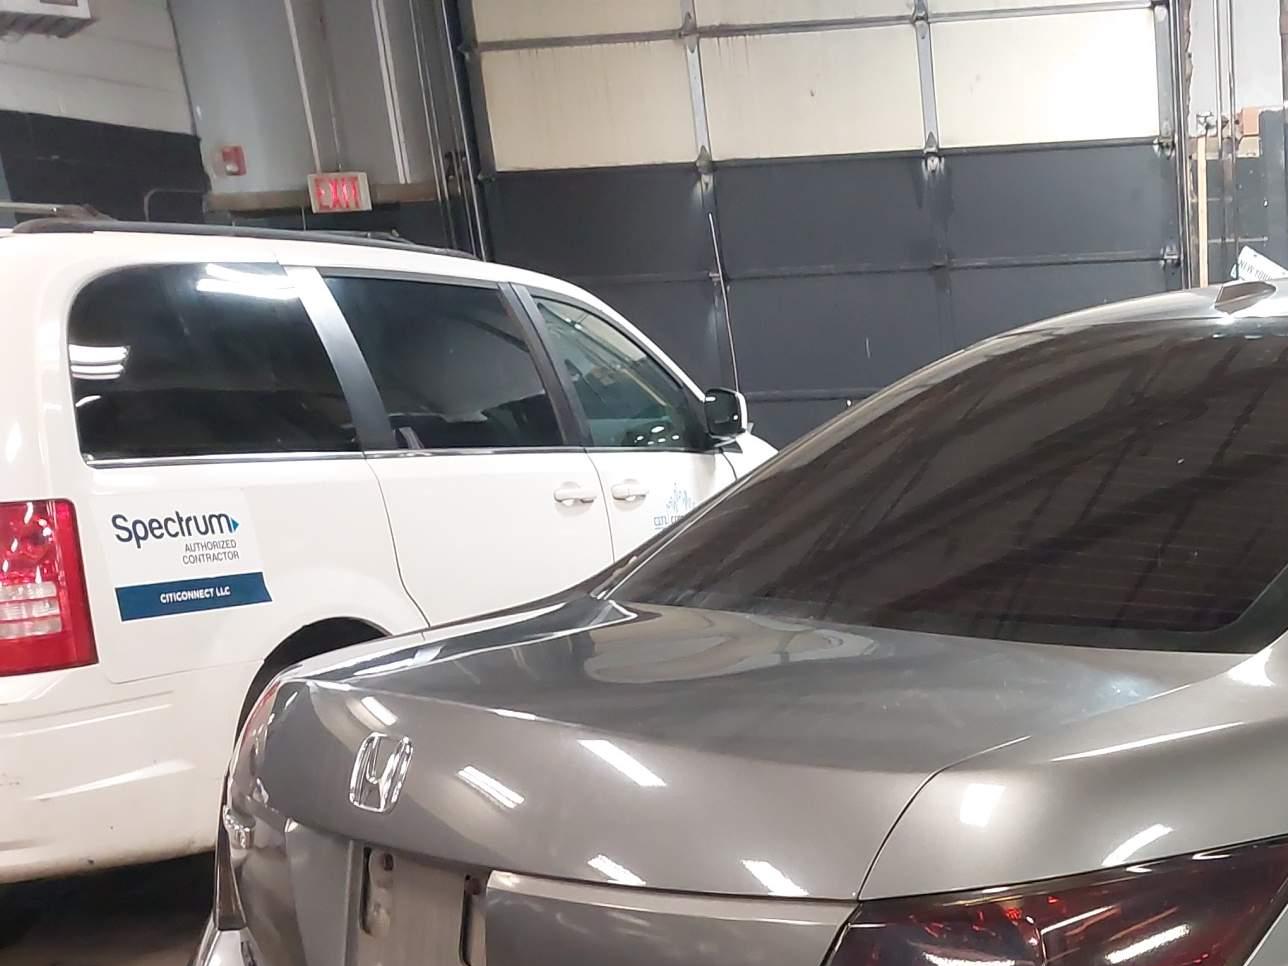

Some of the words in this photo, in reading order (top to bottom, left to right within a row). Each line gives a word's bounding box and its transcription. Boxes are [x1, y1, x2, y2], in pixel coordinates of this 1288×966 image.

[314, 176, 361, 209] EXIT
[111, 511, 233, 549] Spectrum
[185, 539, 237, 552] AUTHORIZED
[182, 551, 240, 565] CONTRACTOR
[160, 587, 214, 603] CITICONNECT
[216, 586, 231, 597] LLC
